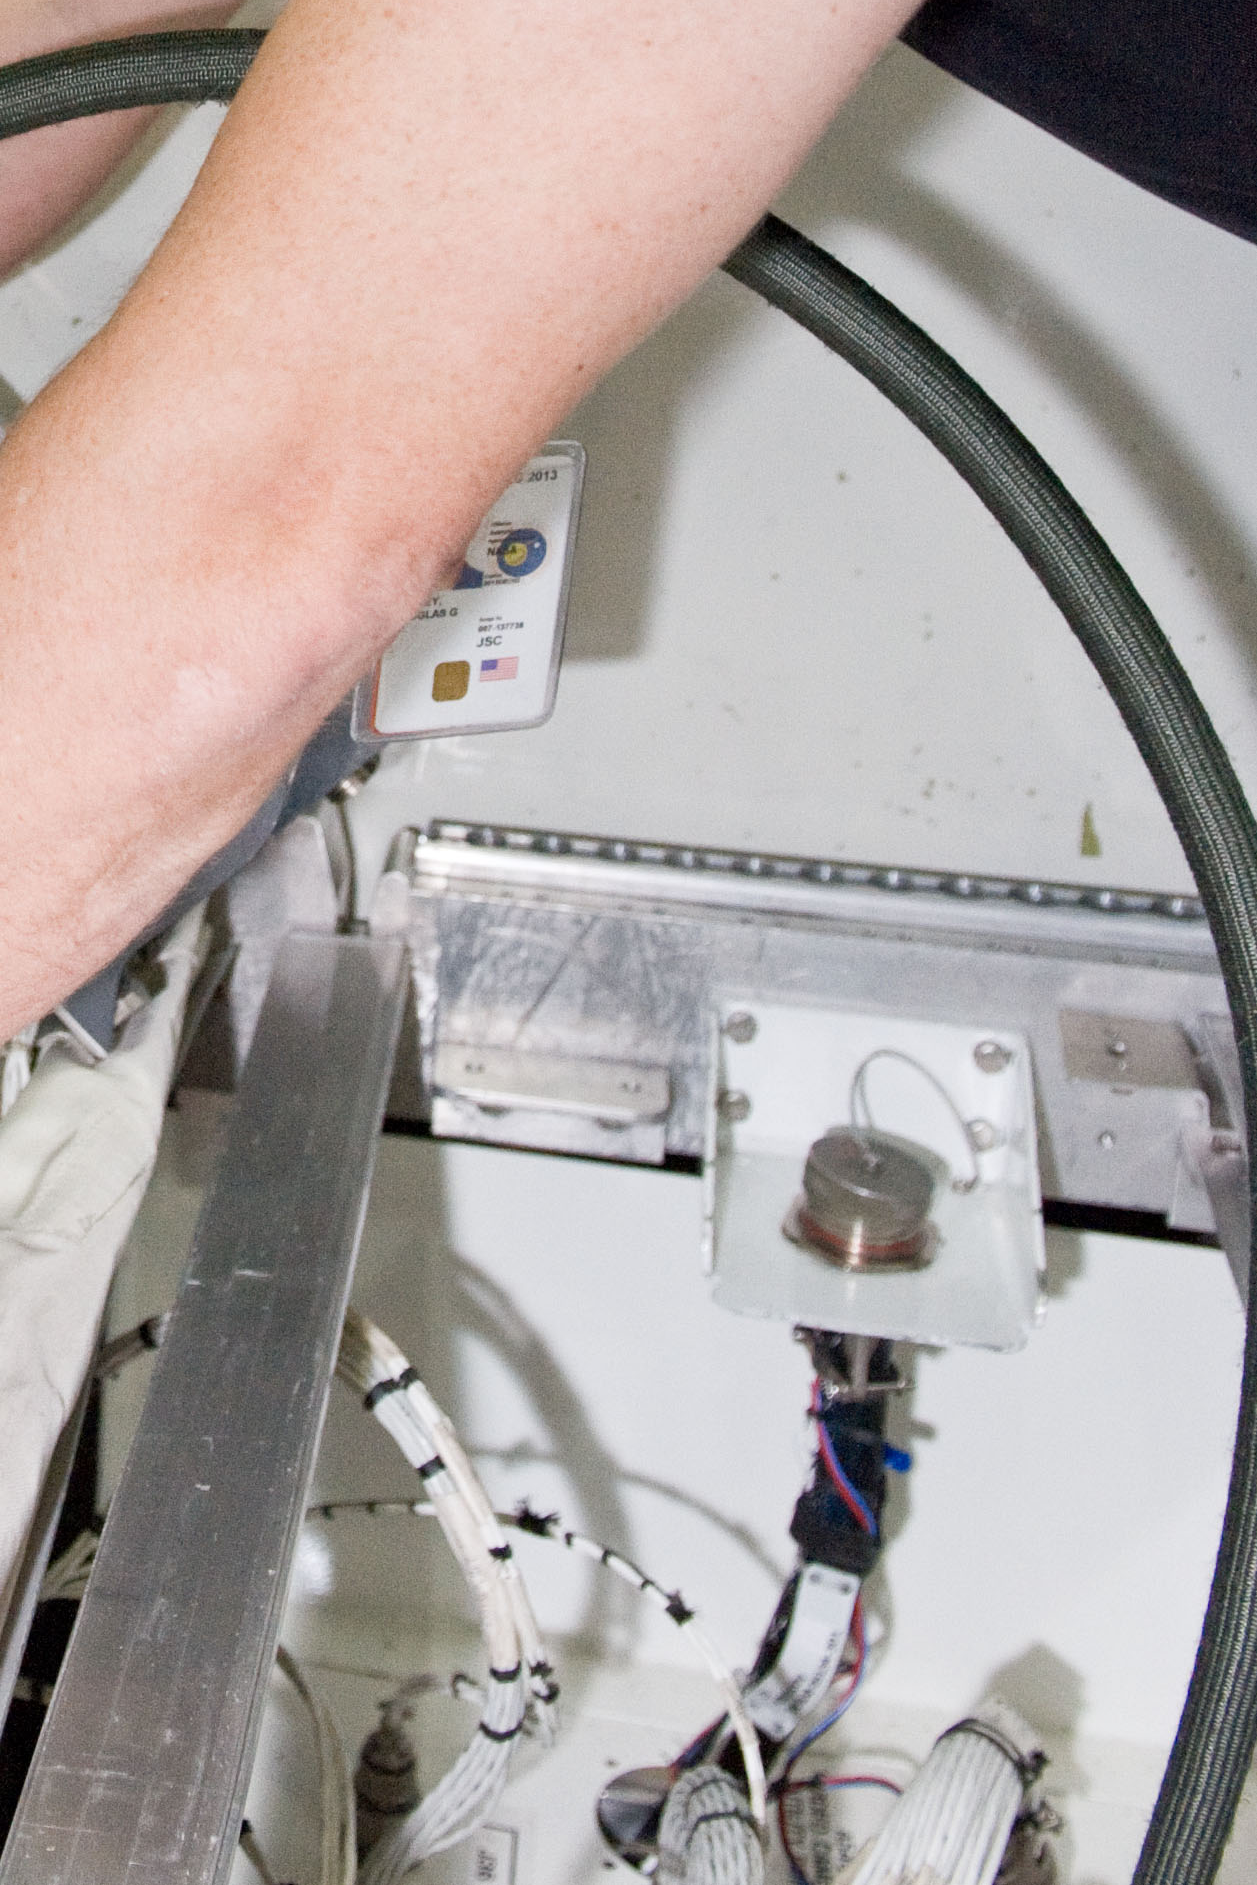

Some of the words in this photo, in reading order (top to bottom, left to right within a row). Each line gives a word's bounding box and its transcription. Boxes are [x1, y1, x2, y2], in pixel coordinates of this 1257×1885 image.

[528, 469, 558, 483] 2013
[449, 606, 459, 617] G
[476, 635, 503, 648] JSC
